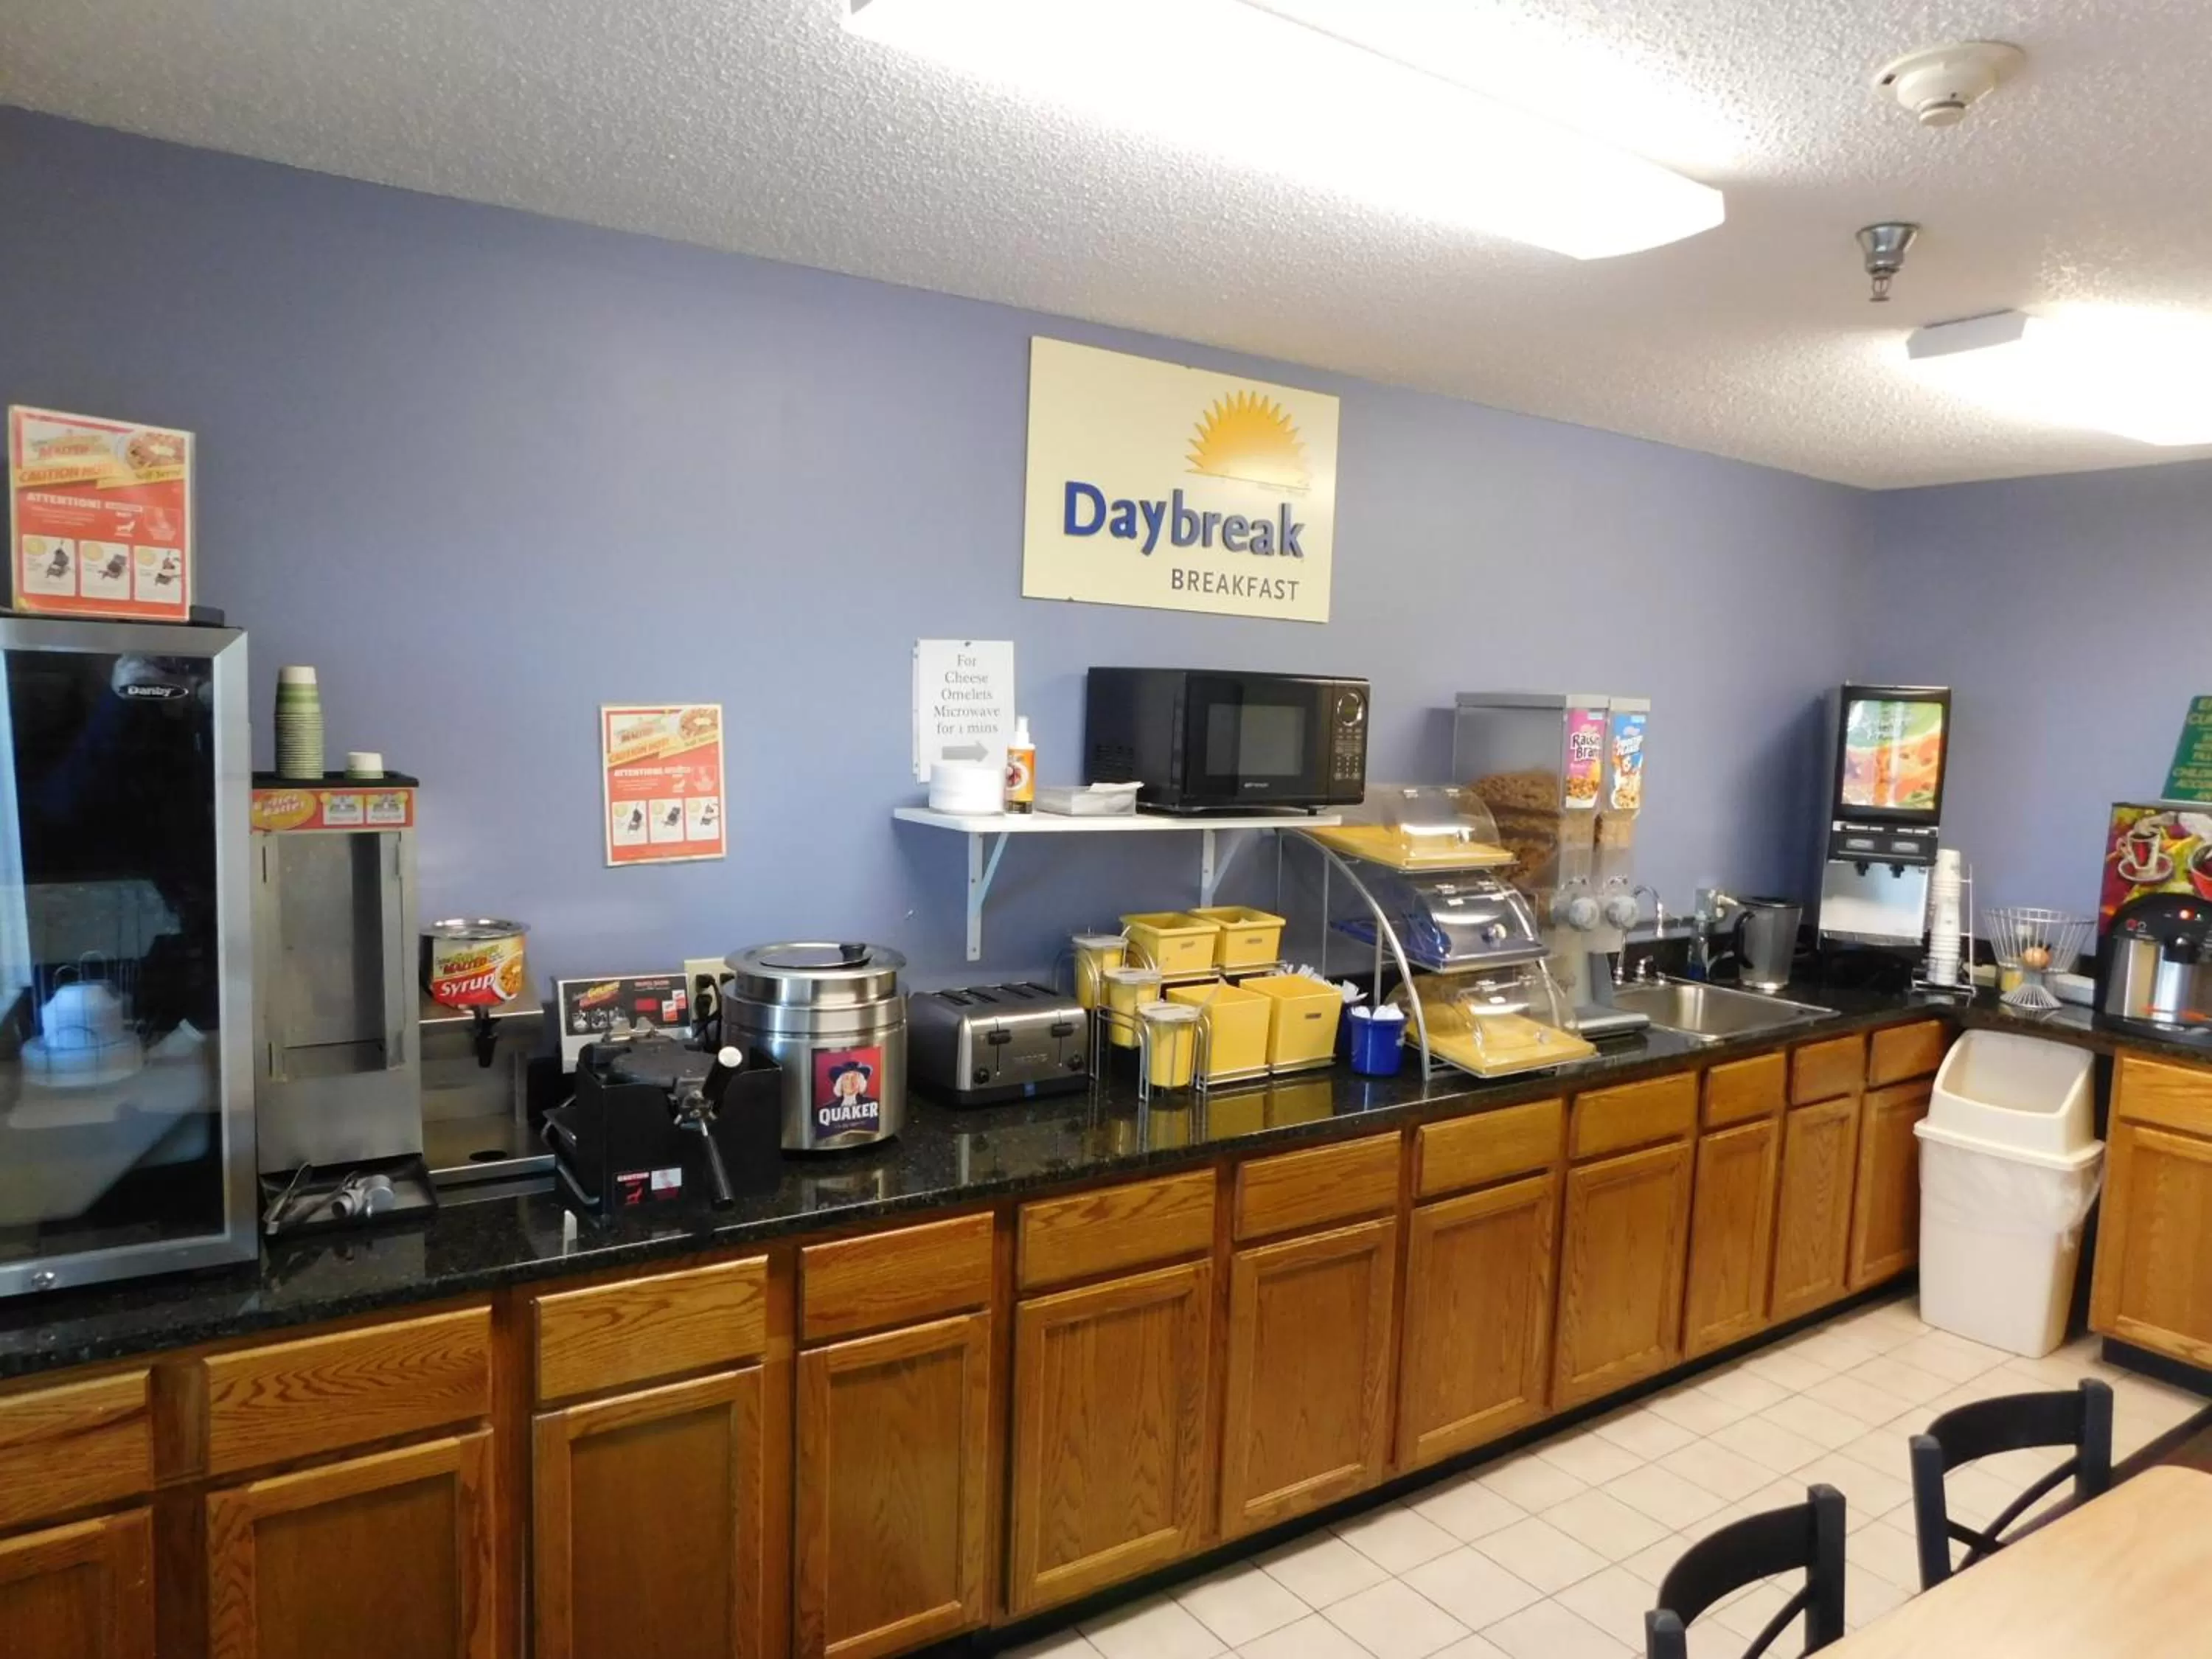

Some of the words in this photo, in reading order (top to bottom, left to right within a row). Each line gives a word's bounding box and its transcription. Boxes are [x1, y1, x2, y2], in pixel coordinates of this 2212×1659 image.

[1064, 481, 1304, 558] Daybreak
[1171, 568, 1299, 602] BREAKFAST
[957, 654, 977, 667] For
[945, 671, 989, 684] Cheese
[128, 686, 171, 697] Danby
[941, 688, 993, 701] Omelets
[933, 705, 1001, 717] Microwave
[936, 723, 954, 734] for
[967, 723, 998, 733] mins
[439, 972, 495, 998] Syrup
[818, 1102, 878, 1127] QUAKER
